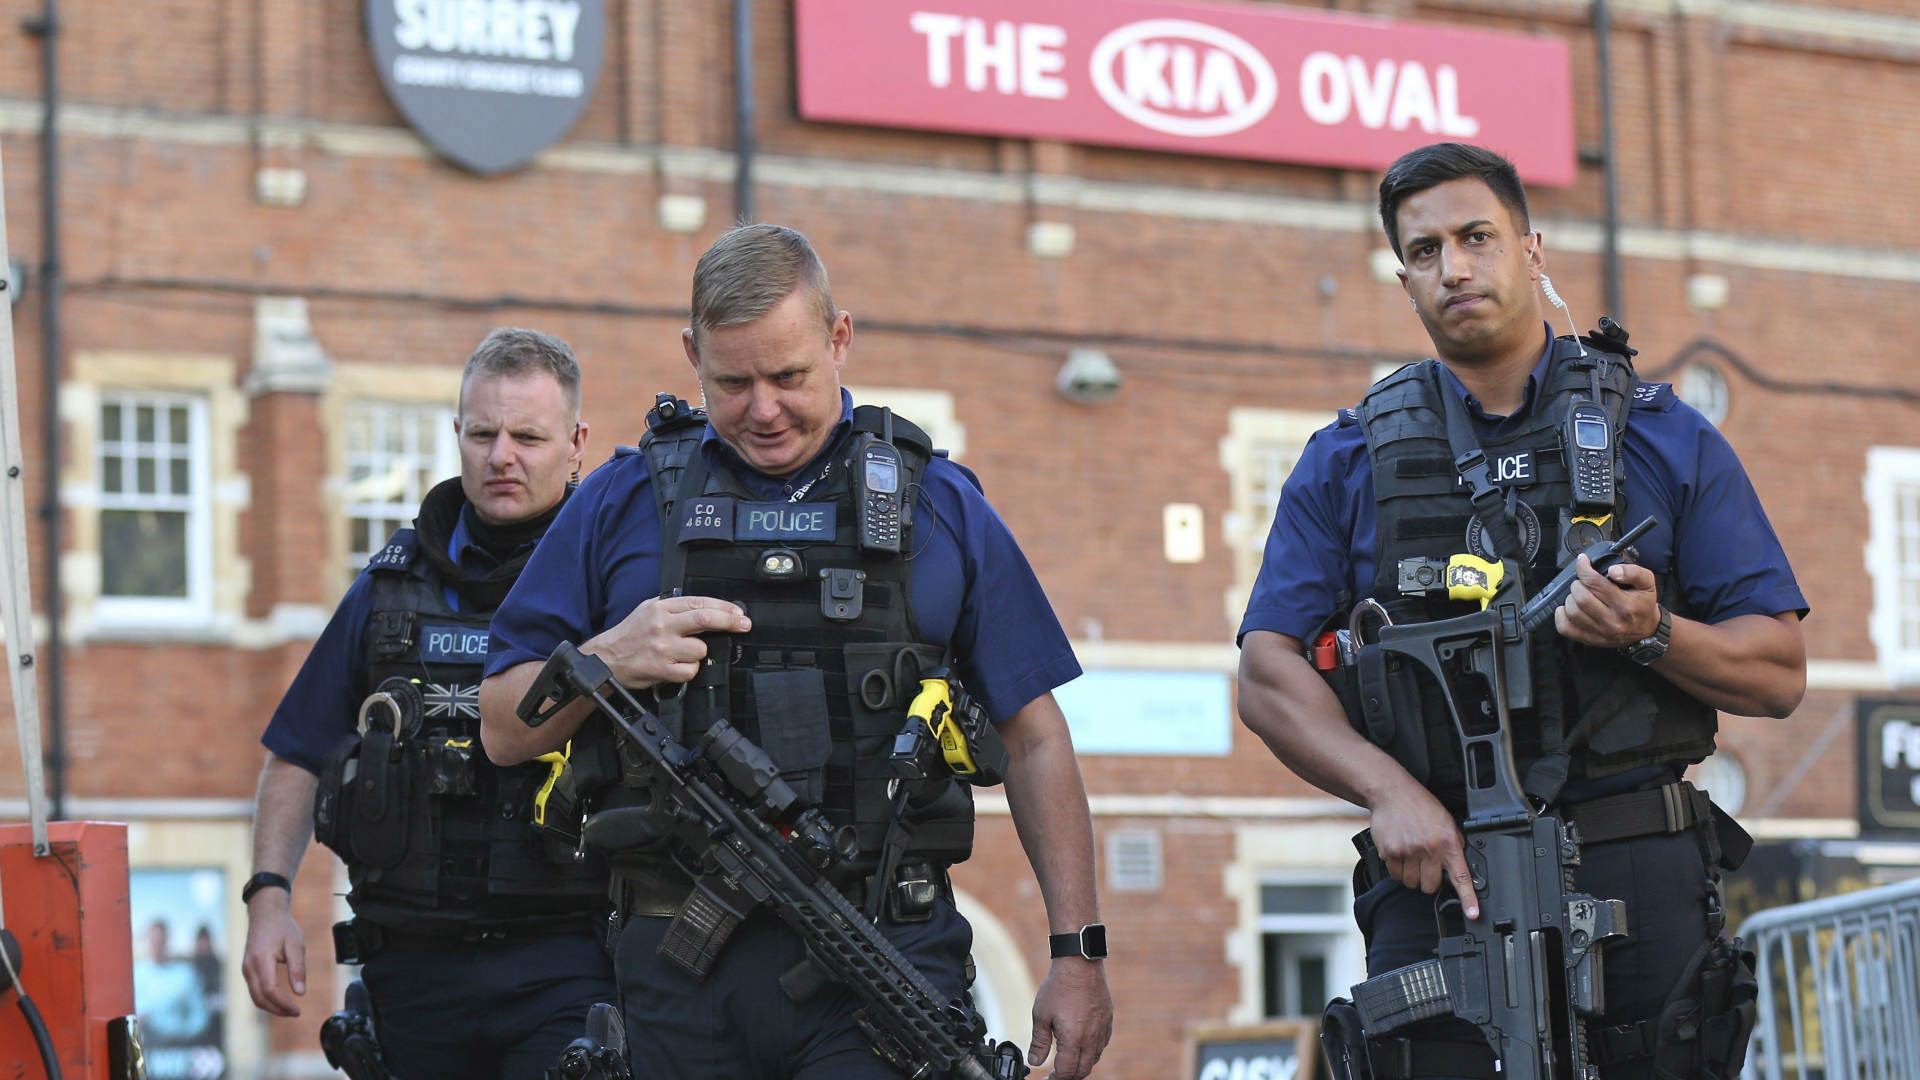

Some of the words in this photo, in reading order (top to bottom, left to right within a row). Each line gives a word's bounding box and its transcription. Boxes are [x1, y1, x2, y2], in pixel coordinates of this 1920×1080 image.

[394, 0, 581, 61] SURREY
[910, 11, 1069, 100] THE
[1122, 41, 1249, 116] KIA
[1300, 51, 1479, 138] OVAL
[695, 503, 715, 515] CO
[749, 510, 824, 532] POLICE
[428, 632, 489, 655] POLICE
